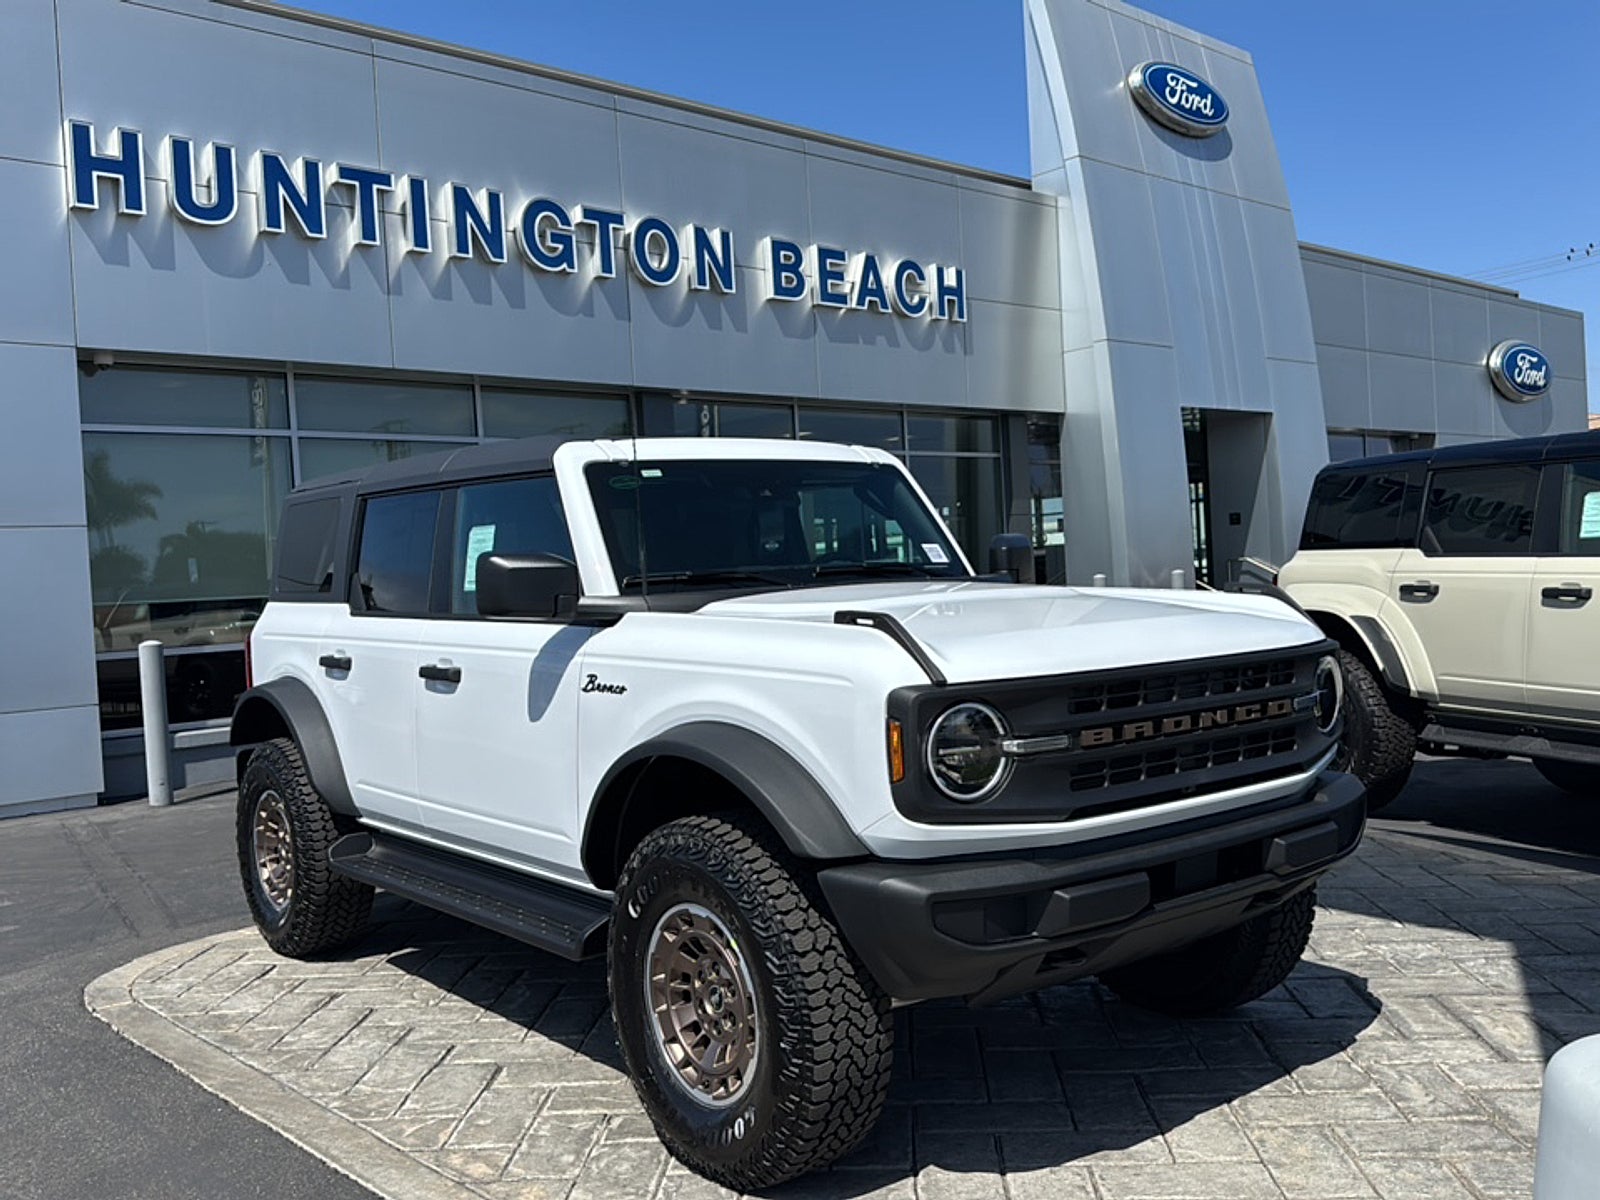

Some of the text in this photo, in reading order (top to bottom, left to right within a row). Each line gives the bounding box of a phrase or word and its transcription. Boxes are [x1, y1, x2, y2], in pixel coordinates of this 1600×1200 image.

[1165, 72, 1214, 117] Ford
[66, 118, 967, 322] HUNTINGTON BEACH
[1514, 352, 1547, 387] Ford
[581, 673, 628, 695] Bronco
[1079, 698, 1292, 747] BRONCO
